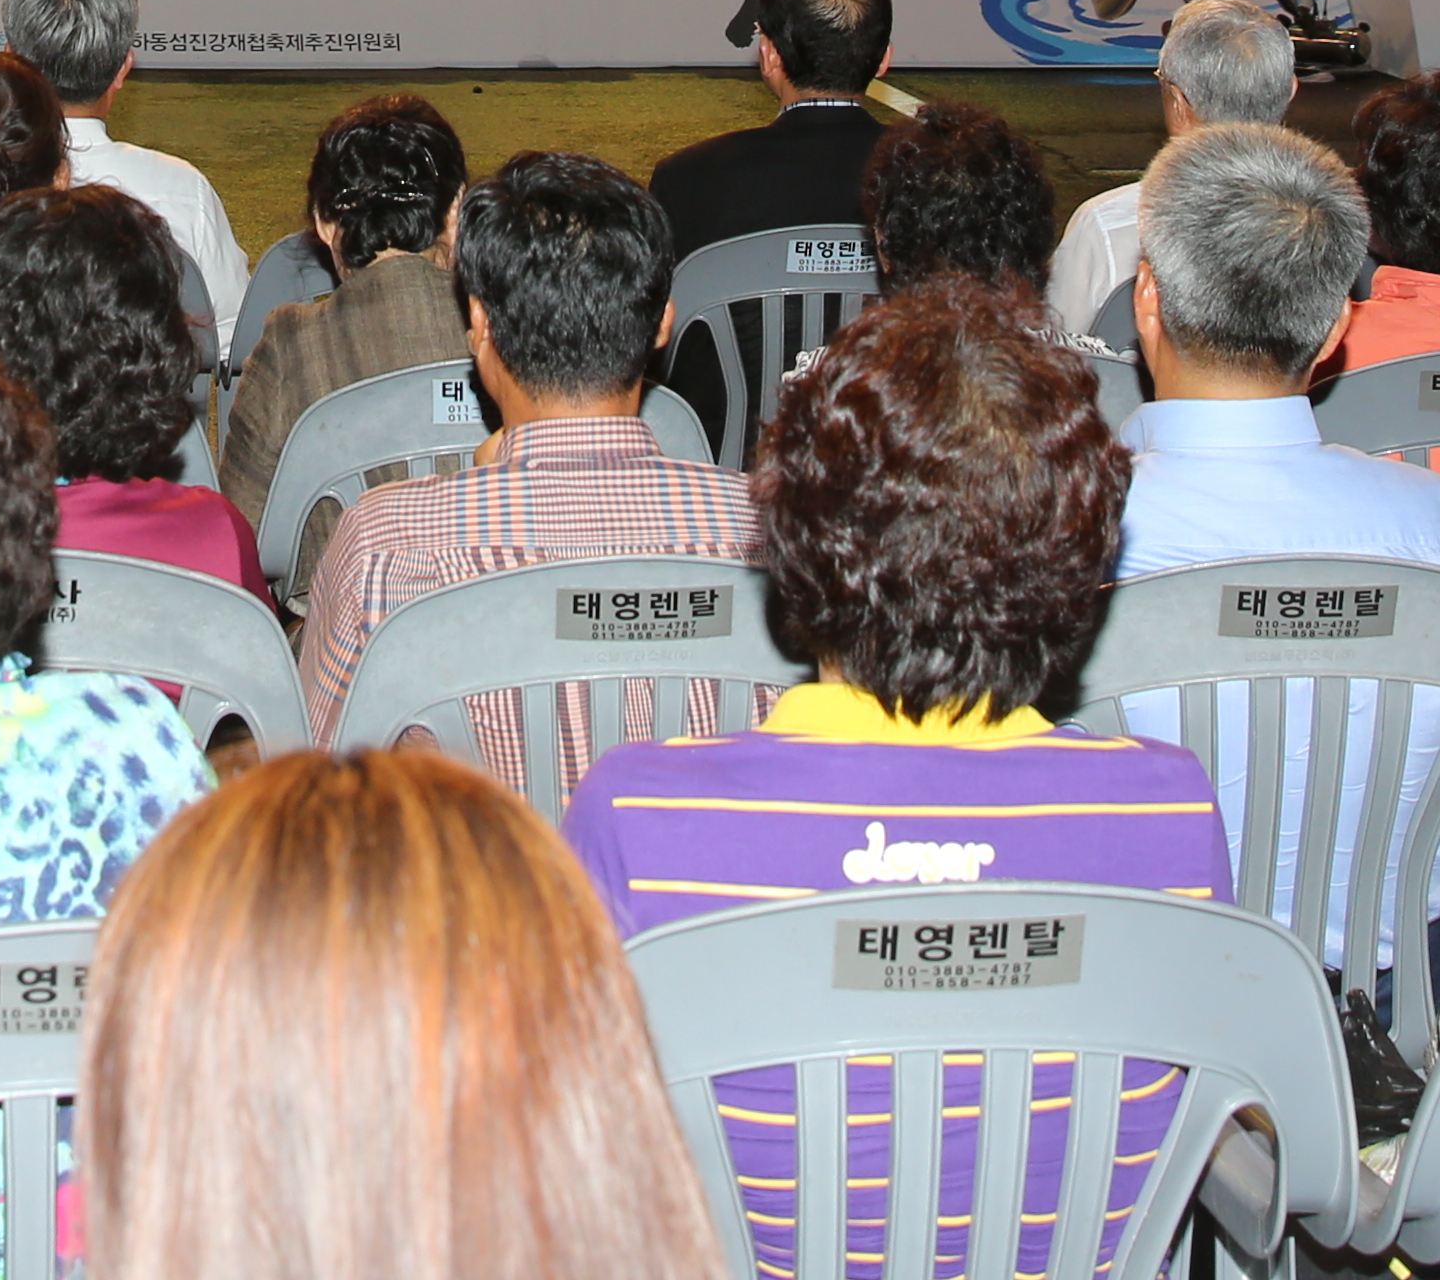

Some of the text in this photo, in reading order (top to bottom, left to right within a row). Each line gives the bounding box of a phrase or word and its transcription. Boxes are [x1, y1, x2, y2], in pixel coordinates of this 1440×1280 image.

[442, 381, 463, 402] 태
[572, 589, 720, 620] 태영렌탈
[1237, 588, 1385, 620] 태영렌탈
[858, 920, 1066, 961] 태영렌탈
[884, 962, 1032, 977] 010-3883-4787
[884, 973, 1032, 988] 011-858-4787
